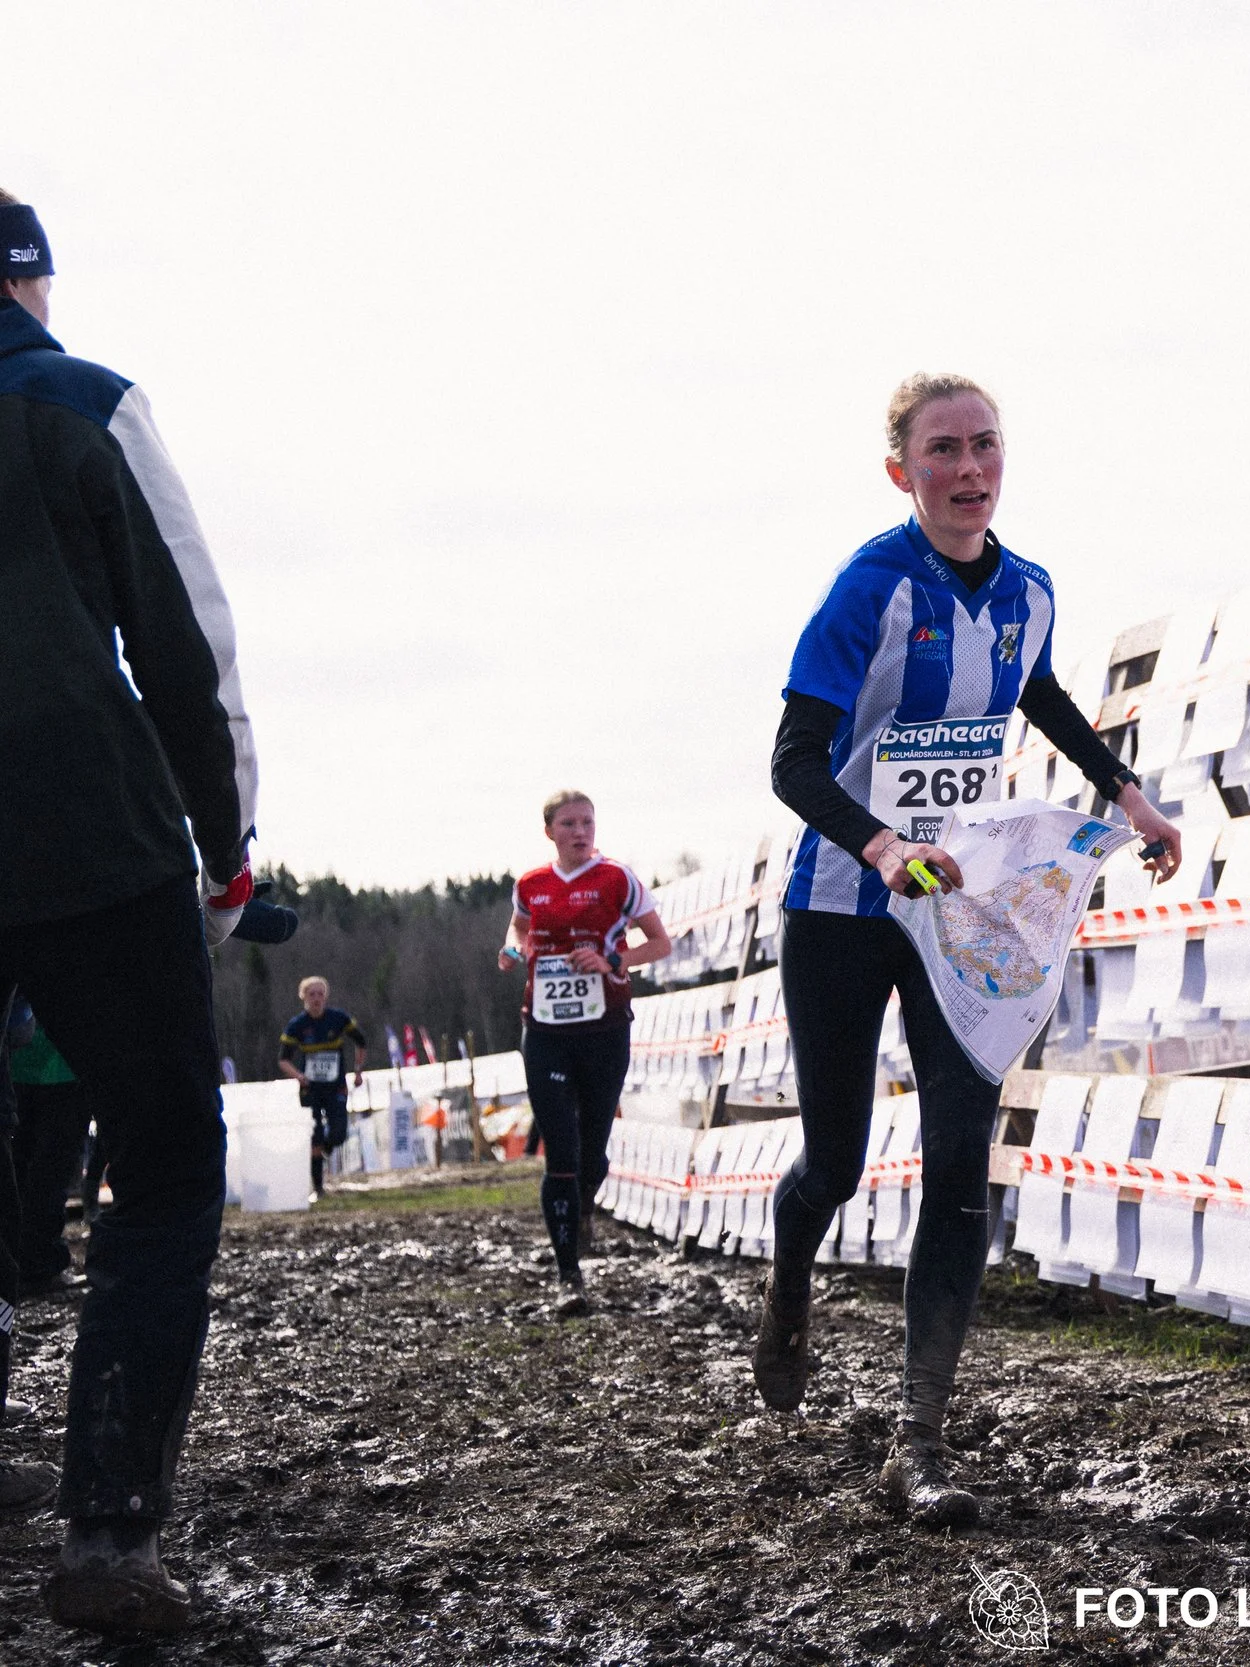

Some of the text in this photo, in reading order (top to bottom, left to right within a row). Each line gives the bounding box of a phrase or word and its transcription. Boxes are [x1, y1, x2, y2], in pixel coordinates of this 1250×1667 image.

[923, 552, 951, 582] barku
[878, 723, 1006, 747] bagheera
[889, 750, 954, 760] KOLMÅRDSKAVLEN
[959, 750, 971, 758] STL
[896, 767, 987, 808] 268
[545, 979, 589, 1001] 228
